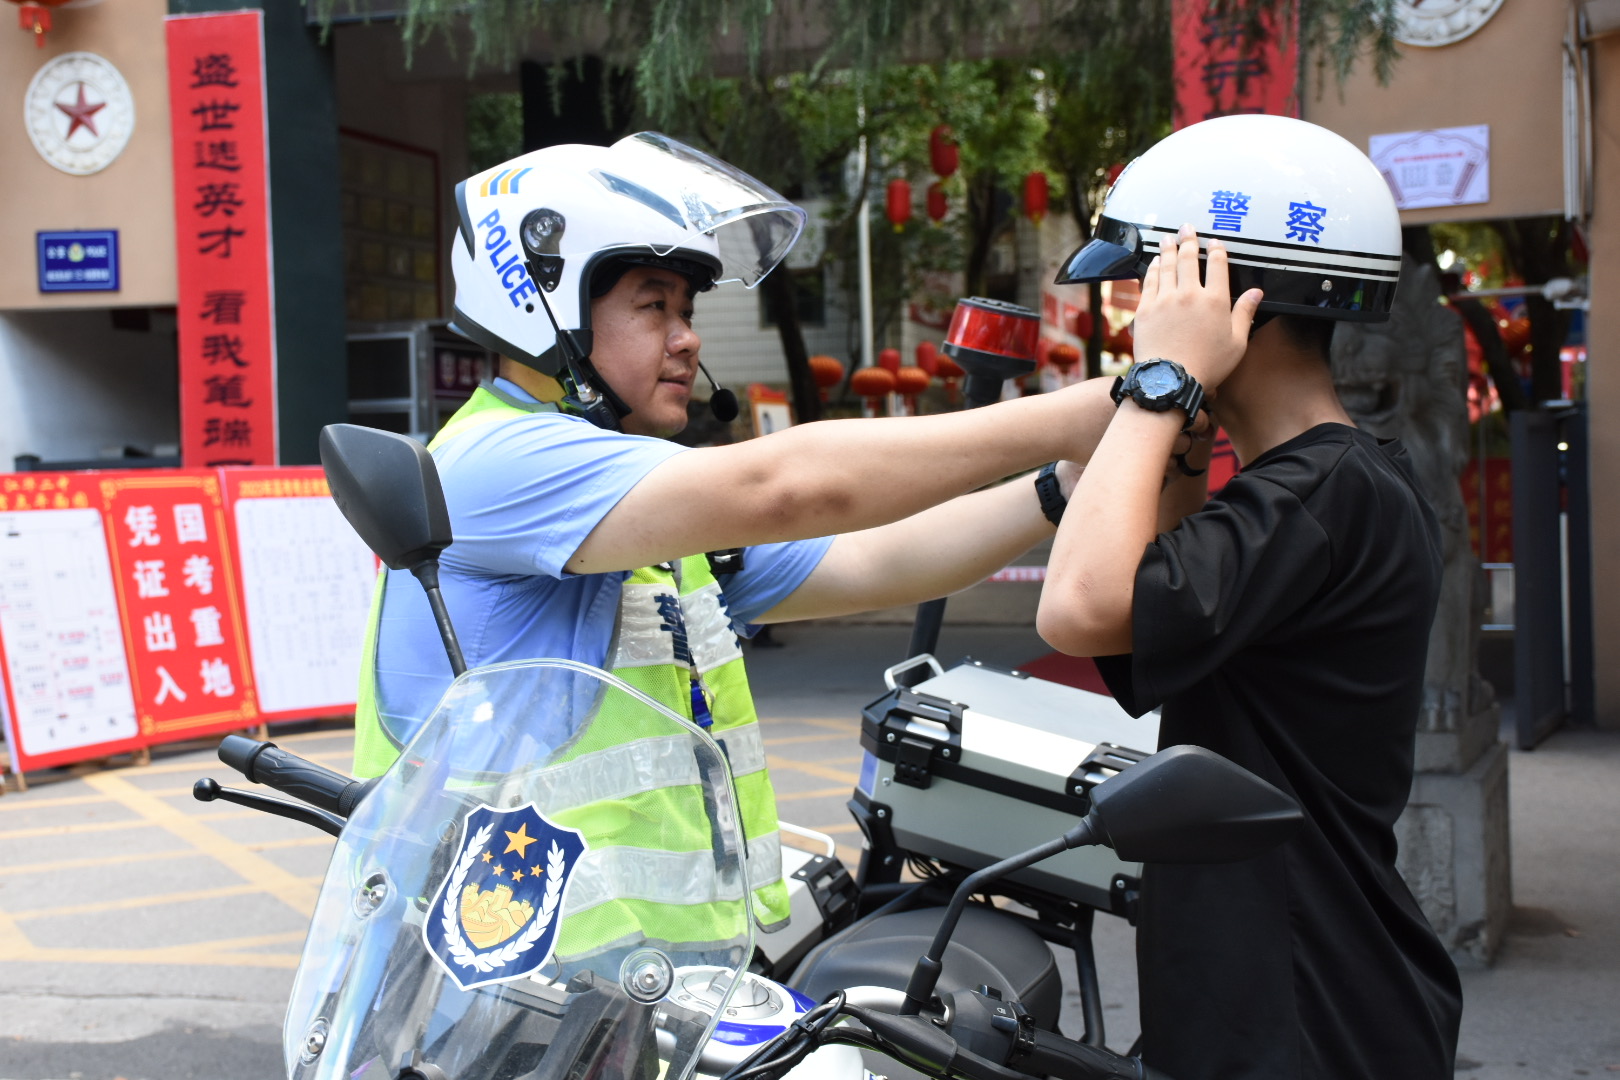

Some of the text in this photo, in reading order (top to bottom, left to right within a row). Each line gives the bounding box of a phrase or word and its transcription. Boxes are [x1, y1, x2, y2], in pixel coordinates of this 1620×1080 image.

[477, 208, 537, 308] POLICE
[1208, 189, 1327, 244] 警察
[124, 504, 187, 706] 凭证出入
[172, 503, 236, 698] 国考重地
